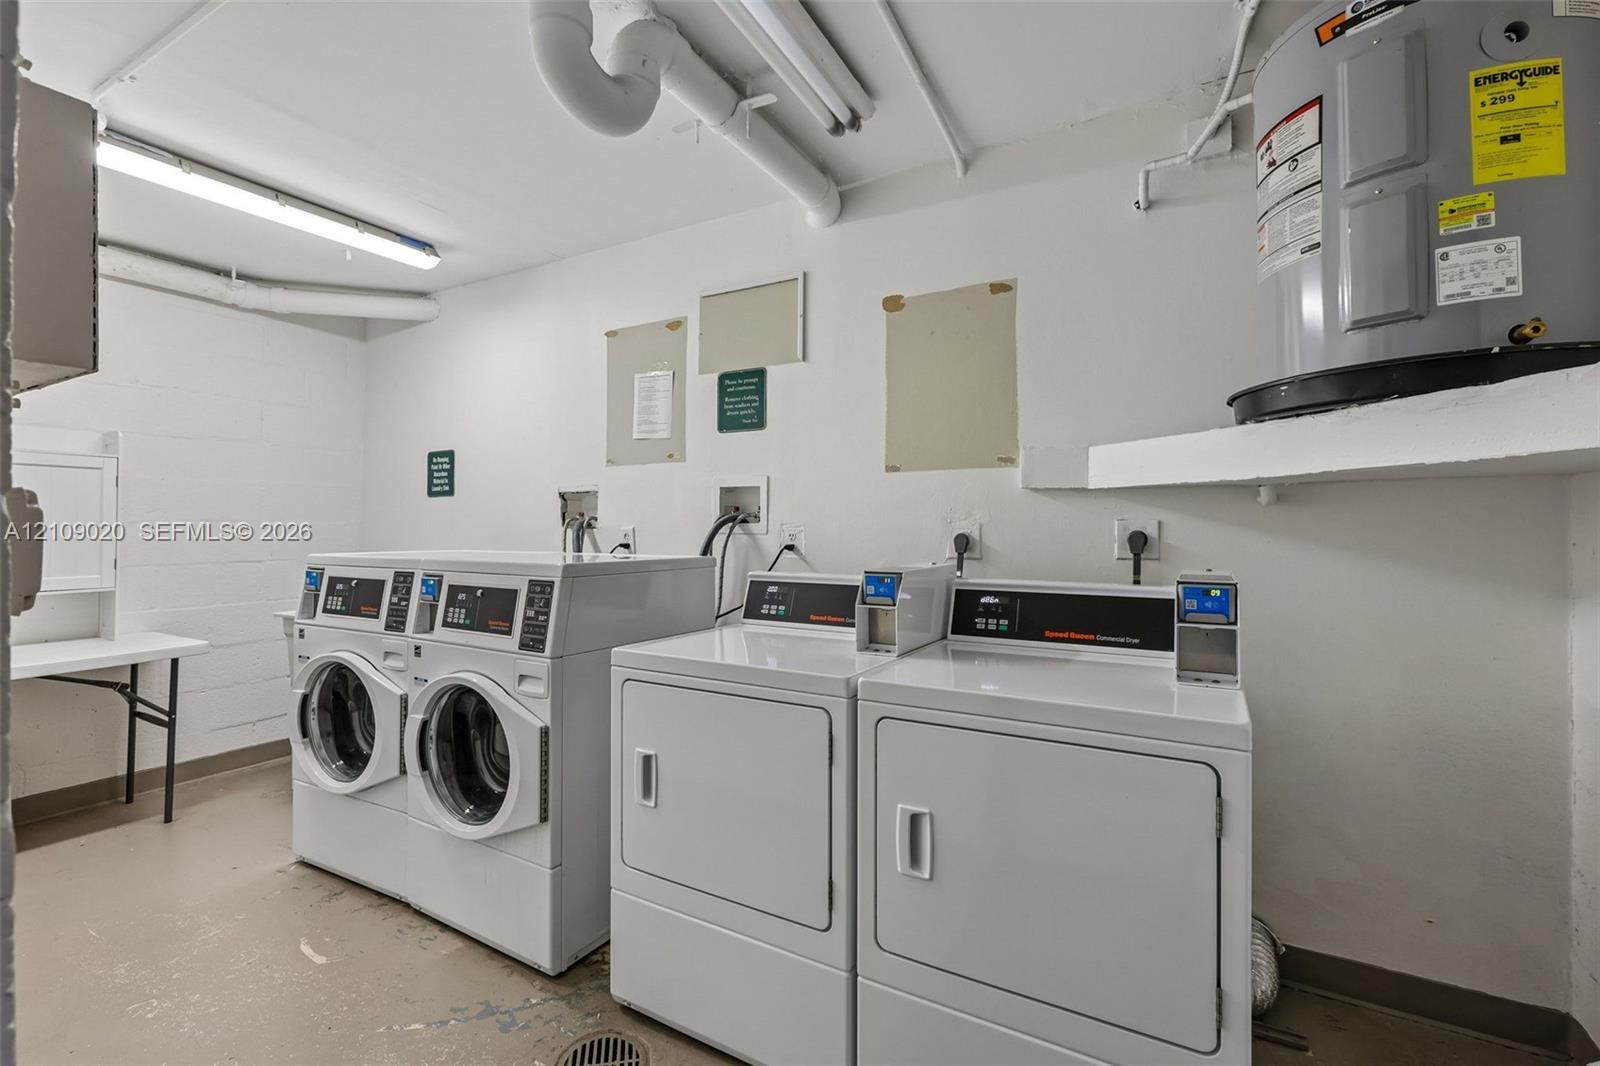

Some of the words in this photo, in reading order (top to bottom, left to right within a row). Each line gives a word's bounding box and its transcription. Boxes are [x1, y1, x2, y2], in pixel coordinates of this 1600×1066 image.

[1474, 65, 1560, 88] ENERGYGUIDE
[1490, 94, 1515, 106] 299
[1210, 589, 1221, 597] 09
[1044, 630, 1069, 639] Speed
[1069, 632, 1095, 640] Queen
[1096, 634, 1125, 643] Commercial
[1126, 637, 1140, 645] Dryer
